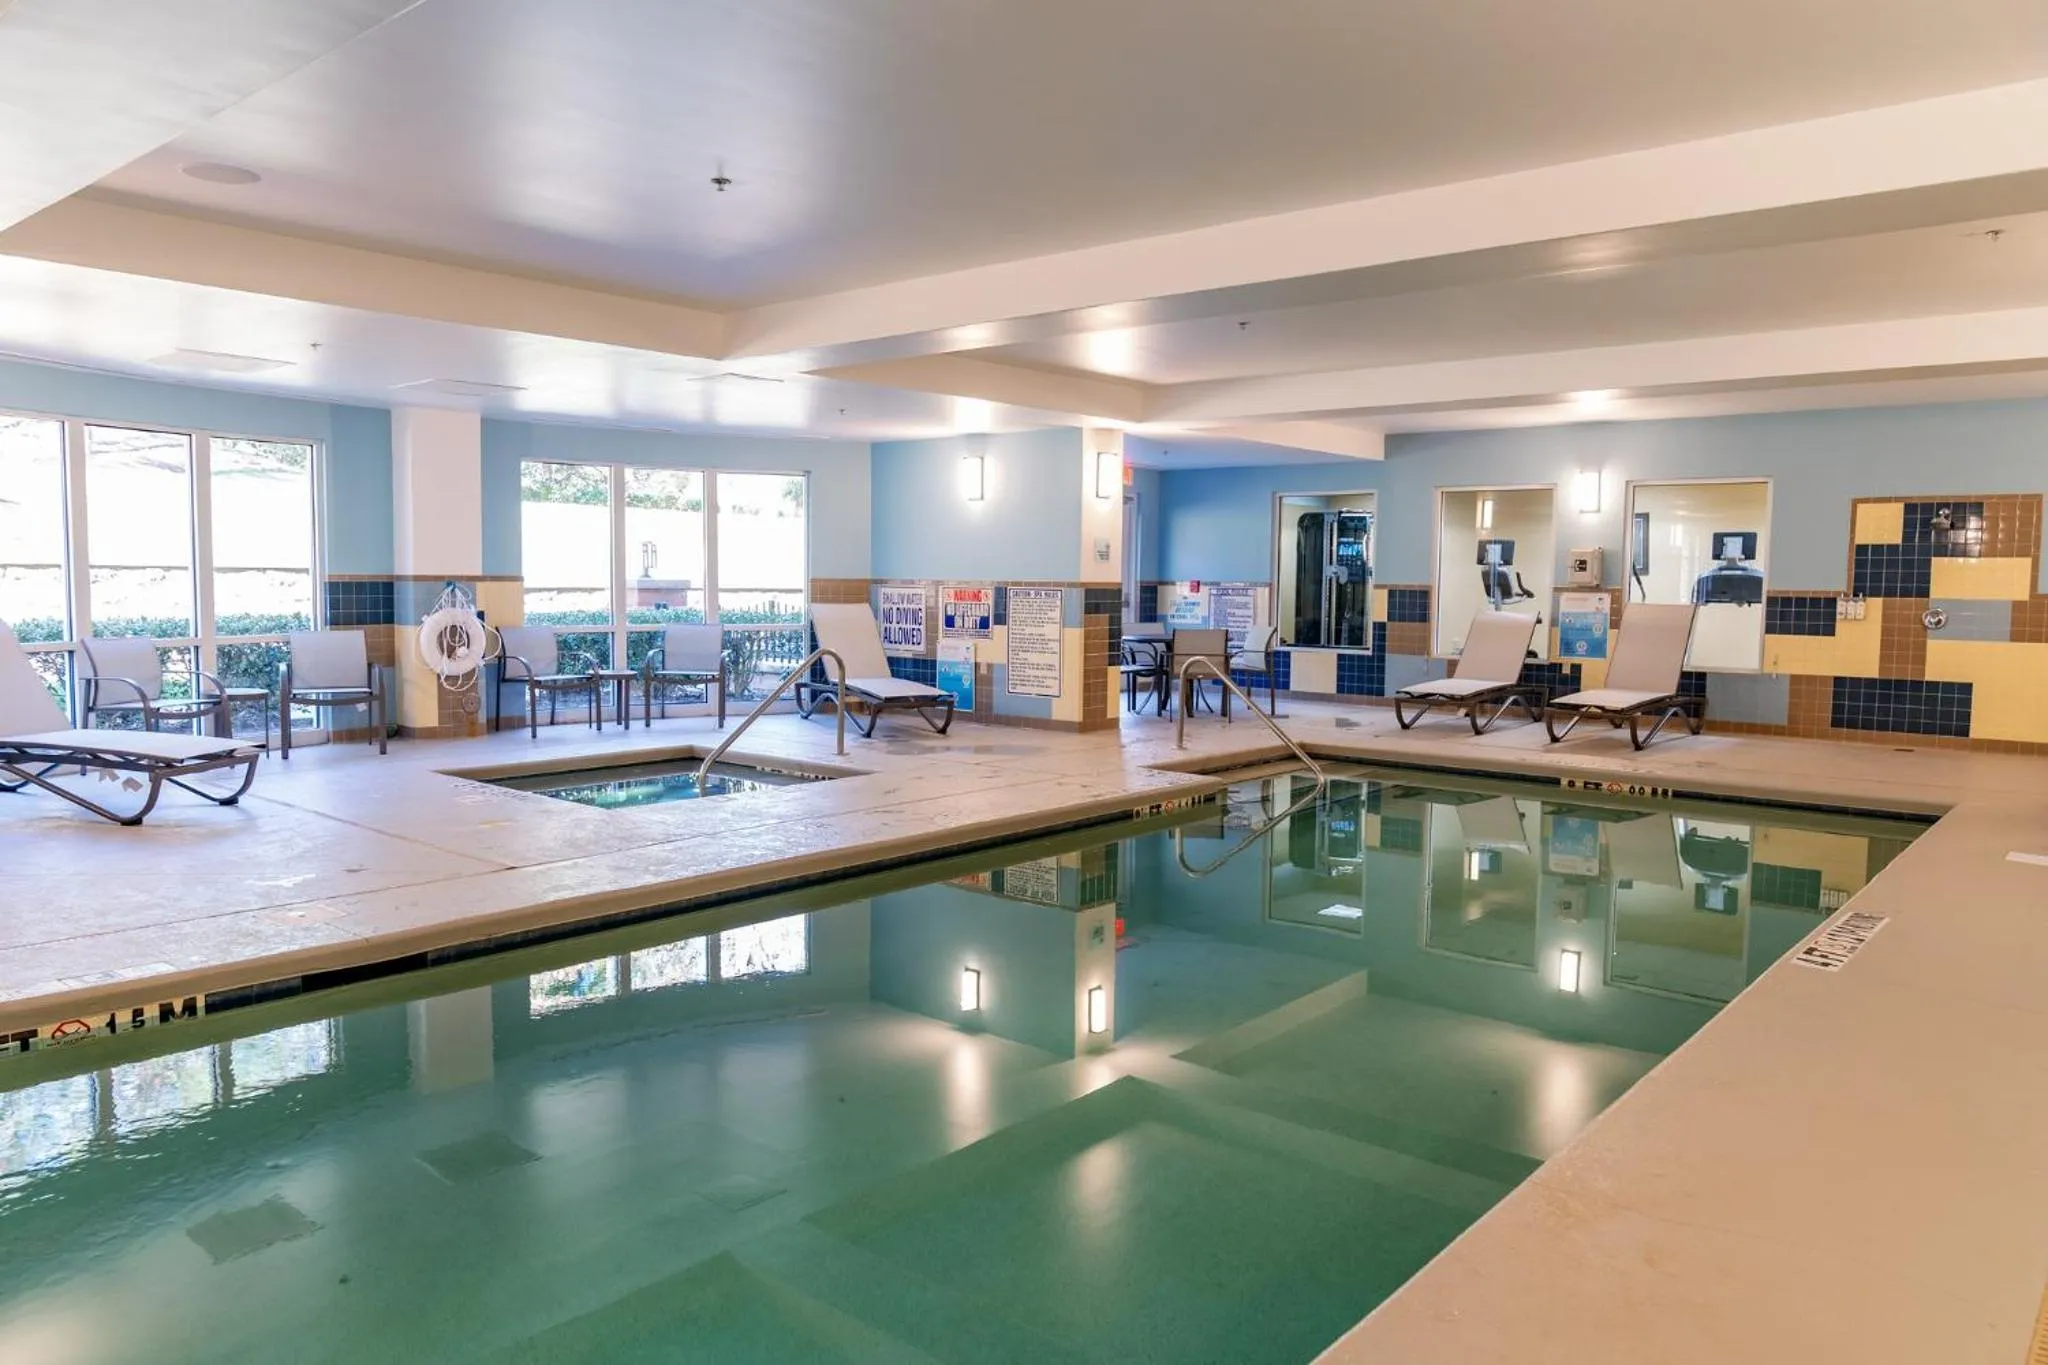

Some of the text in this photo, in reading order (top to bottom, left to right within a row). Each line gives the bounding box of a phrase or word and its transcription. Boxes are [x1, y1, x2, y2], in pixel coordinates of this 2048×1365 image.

[882, 592, 923, 605] SHALLOW WATER
[953, 590, 982, 602] WARNING
[883, 607, 923, 626] NO DIVING
[883, 626, 923, 646] ALLOWED
